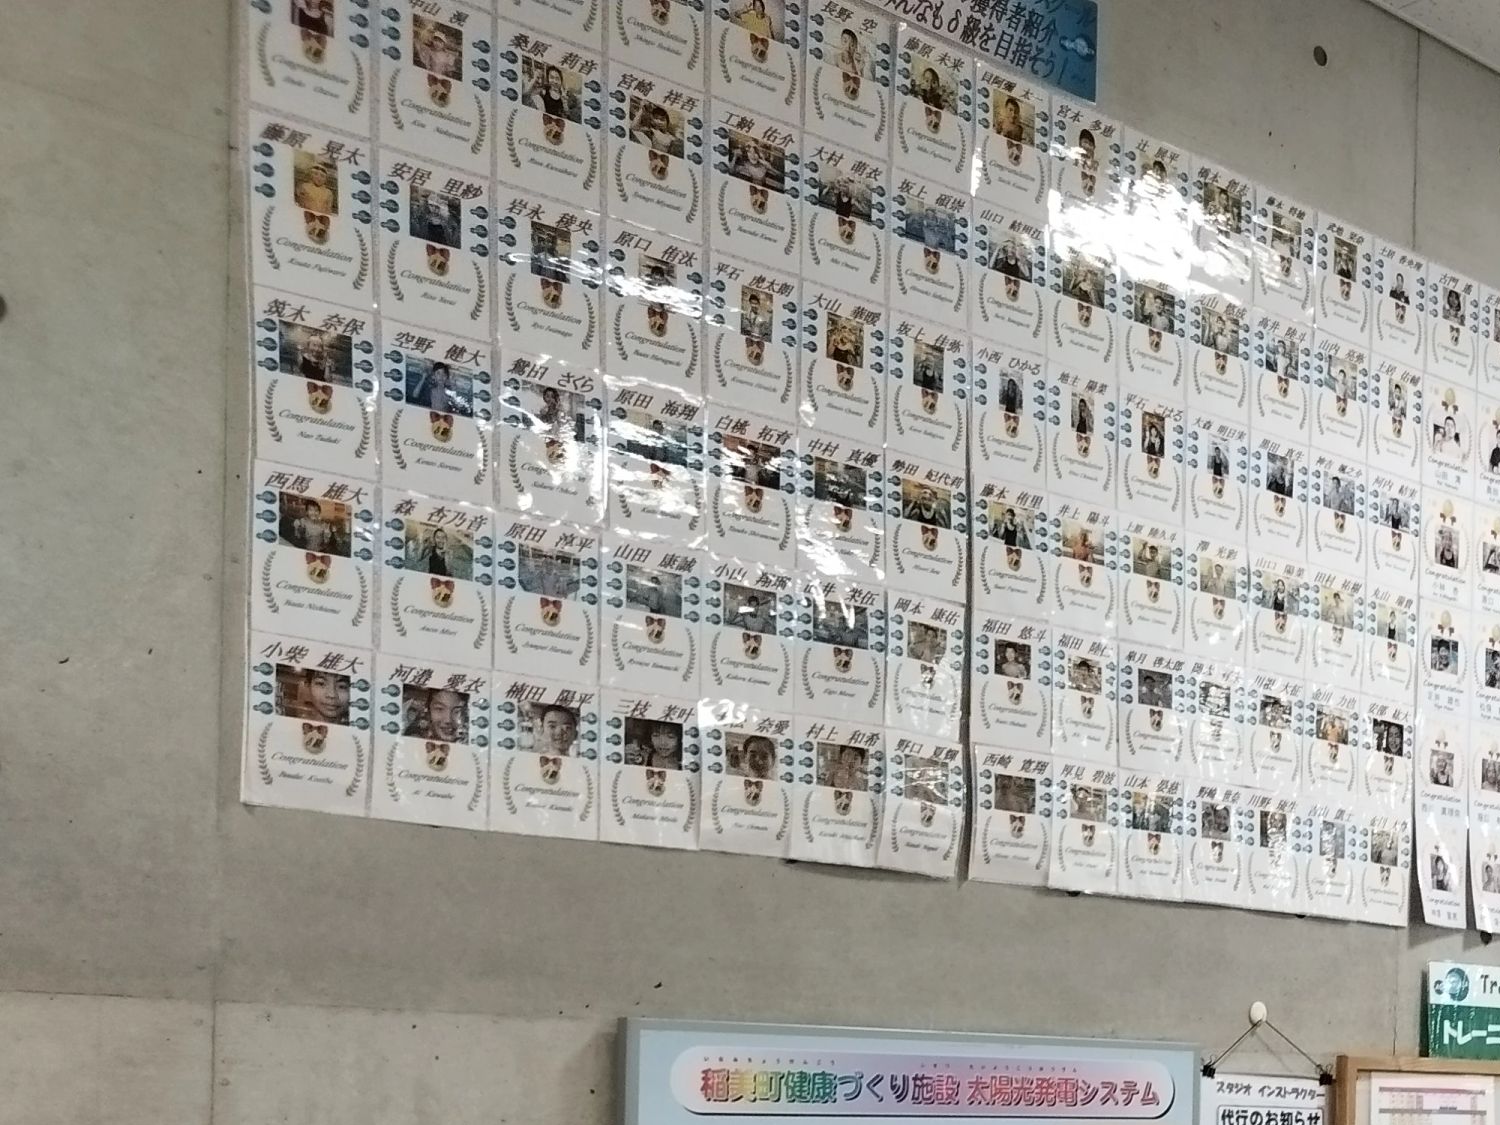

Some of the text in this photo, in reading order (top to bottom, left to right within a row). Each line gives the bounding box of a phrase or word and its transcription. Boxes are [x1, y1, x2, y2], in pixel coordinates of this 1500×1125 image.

[400, 269, 472, 295] Congratulation
[557, 371, 595, 394] さくら
[403, 437, 475, 460] Congratulation
[276, 579, 353, 600] Congratulation
[403, 604, 475, 625] Congratulation
[317, 651, 364, 675] 雄大
[271, 751, 349, 771] Congratulation
[700, 1066, 1161, 1107] 稲美町健康づくり施設 太陽光発電システム
[1216, 1080, 1326, 1101] スタジオ インストラクター
